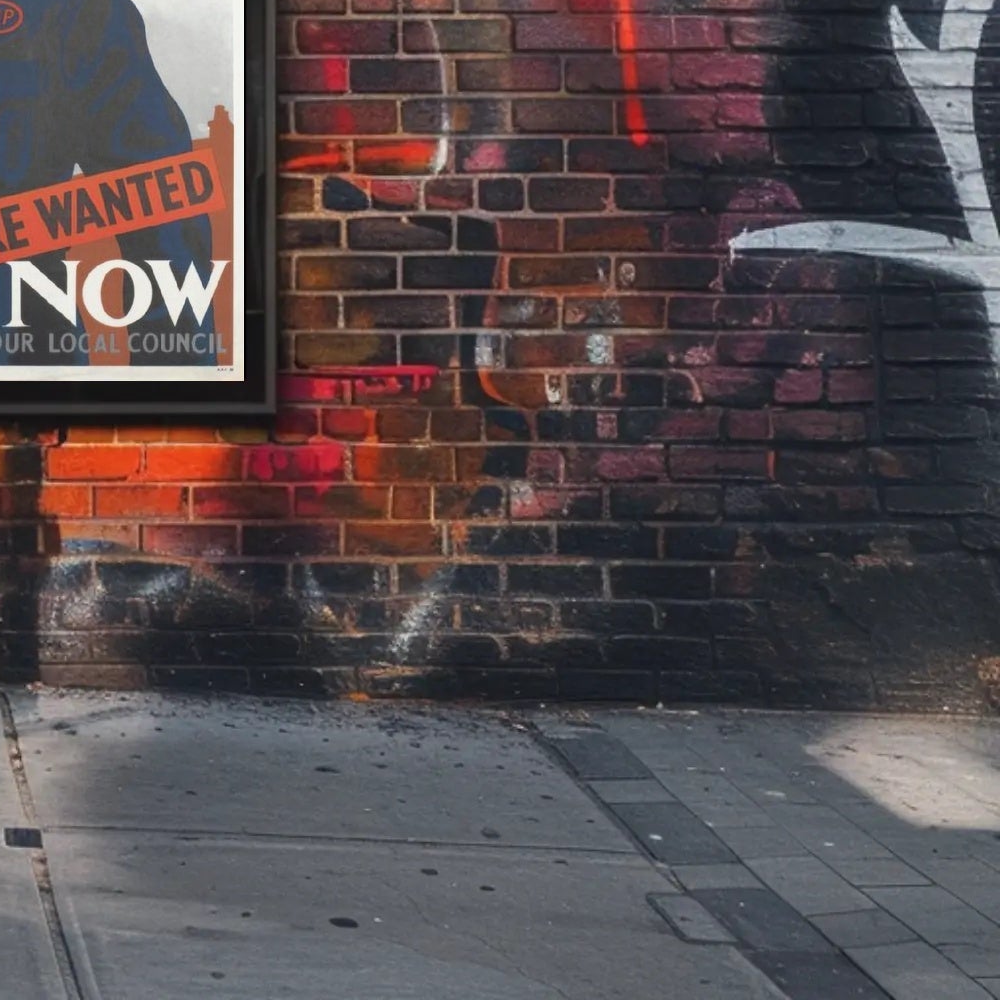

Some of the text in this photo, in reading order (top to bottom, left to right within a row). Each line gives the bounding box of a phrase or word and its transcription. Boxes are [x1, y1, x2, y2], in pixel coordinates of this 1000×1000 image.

[33, 160, 215, 240] WANTED
[0, 259, 230, 328] NOW
[48, 331, 121, 353] LOCAL
[127, 331, 227, 353] COUNCIL
